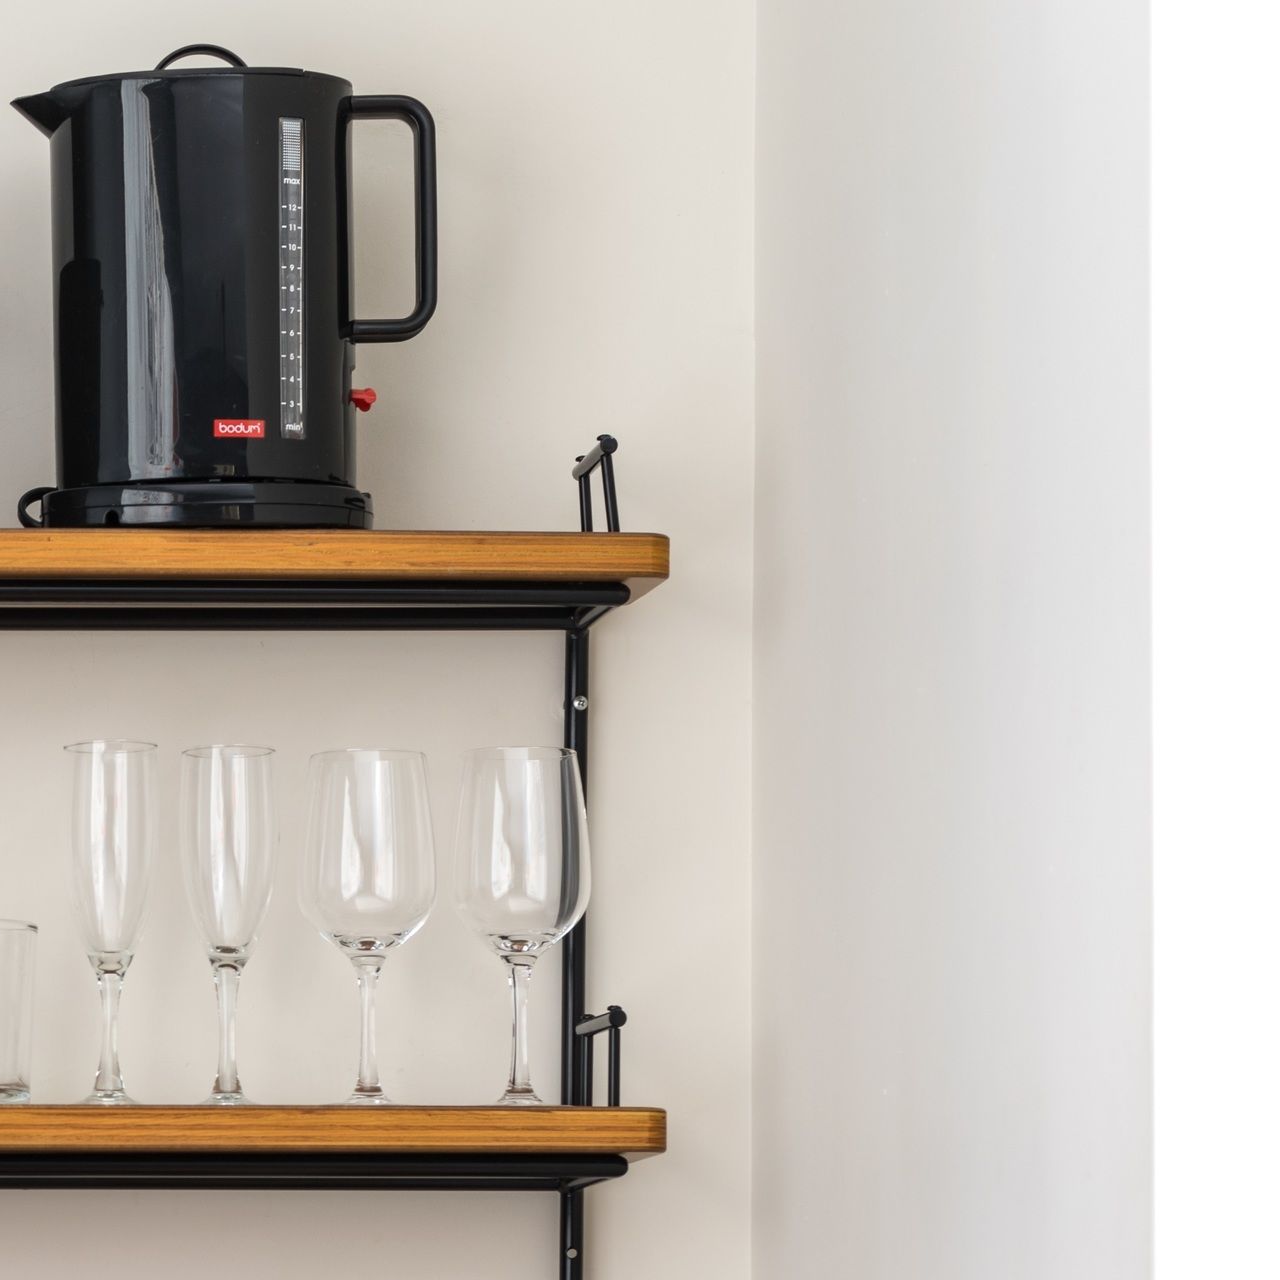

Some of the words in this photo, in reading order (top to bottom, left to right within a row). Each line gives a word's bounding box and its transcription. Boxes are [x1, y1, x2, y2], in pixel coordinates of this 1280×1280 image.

[283, 177, 301, 185] max
[288, 203, 297, 211] 12
[289, 223, 297, 231] 11
[288, 243, 297, 251] 10
[218, 422, 261, 434] bodum
[285, 423, 301, 431] min
